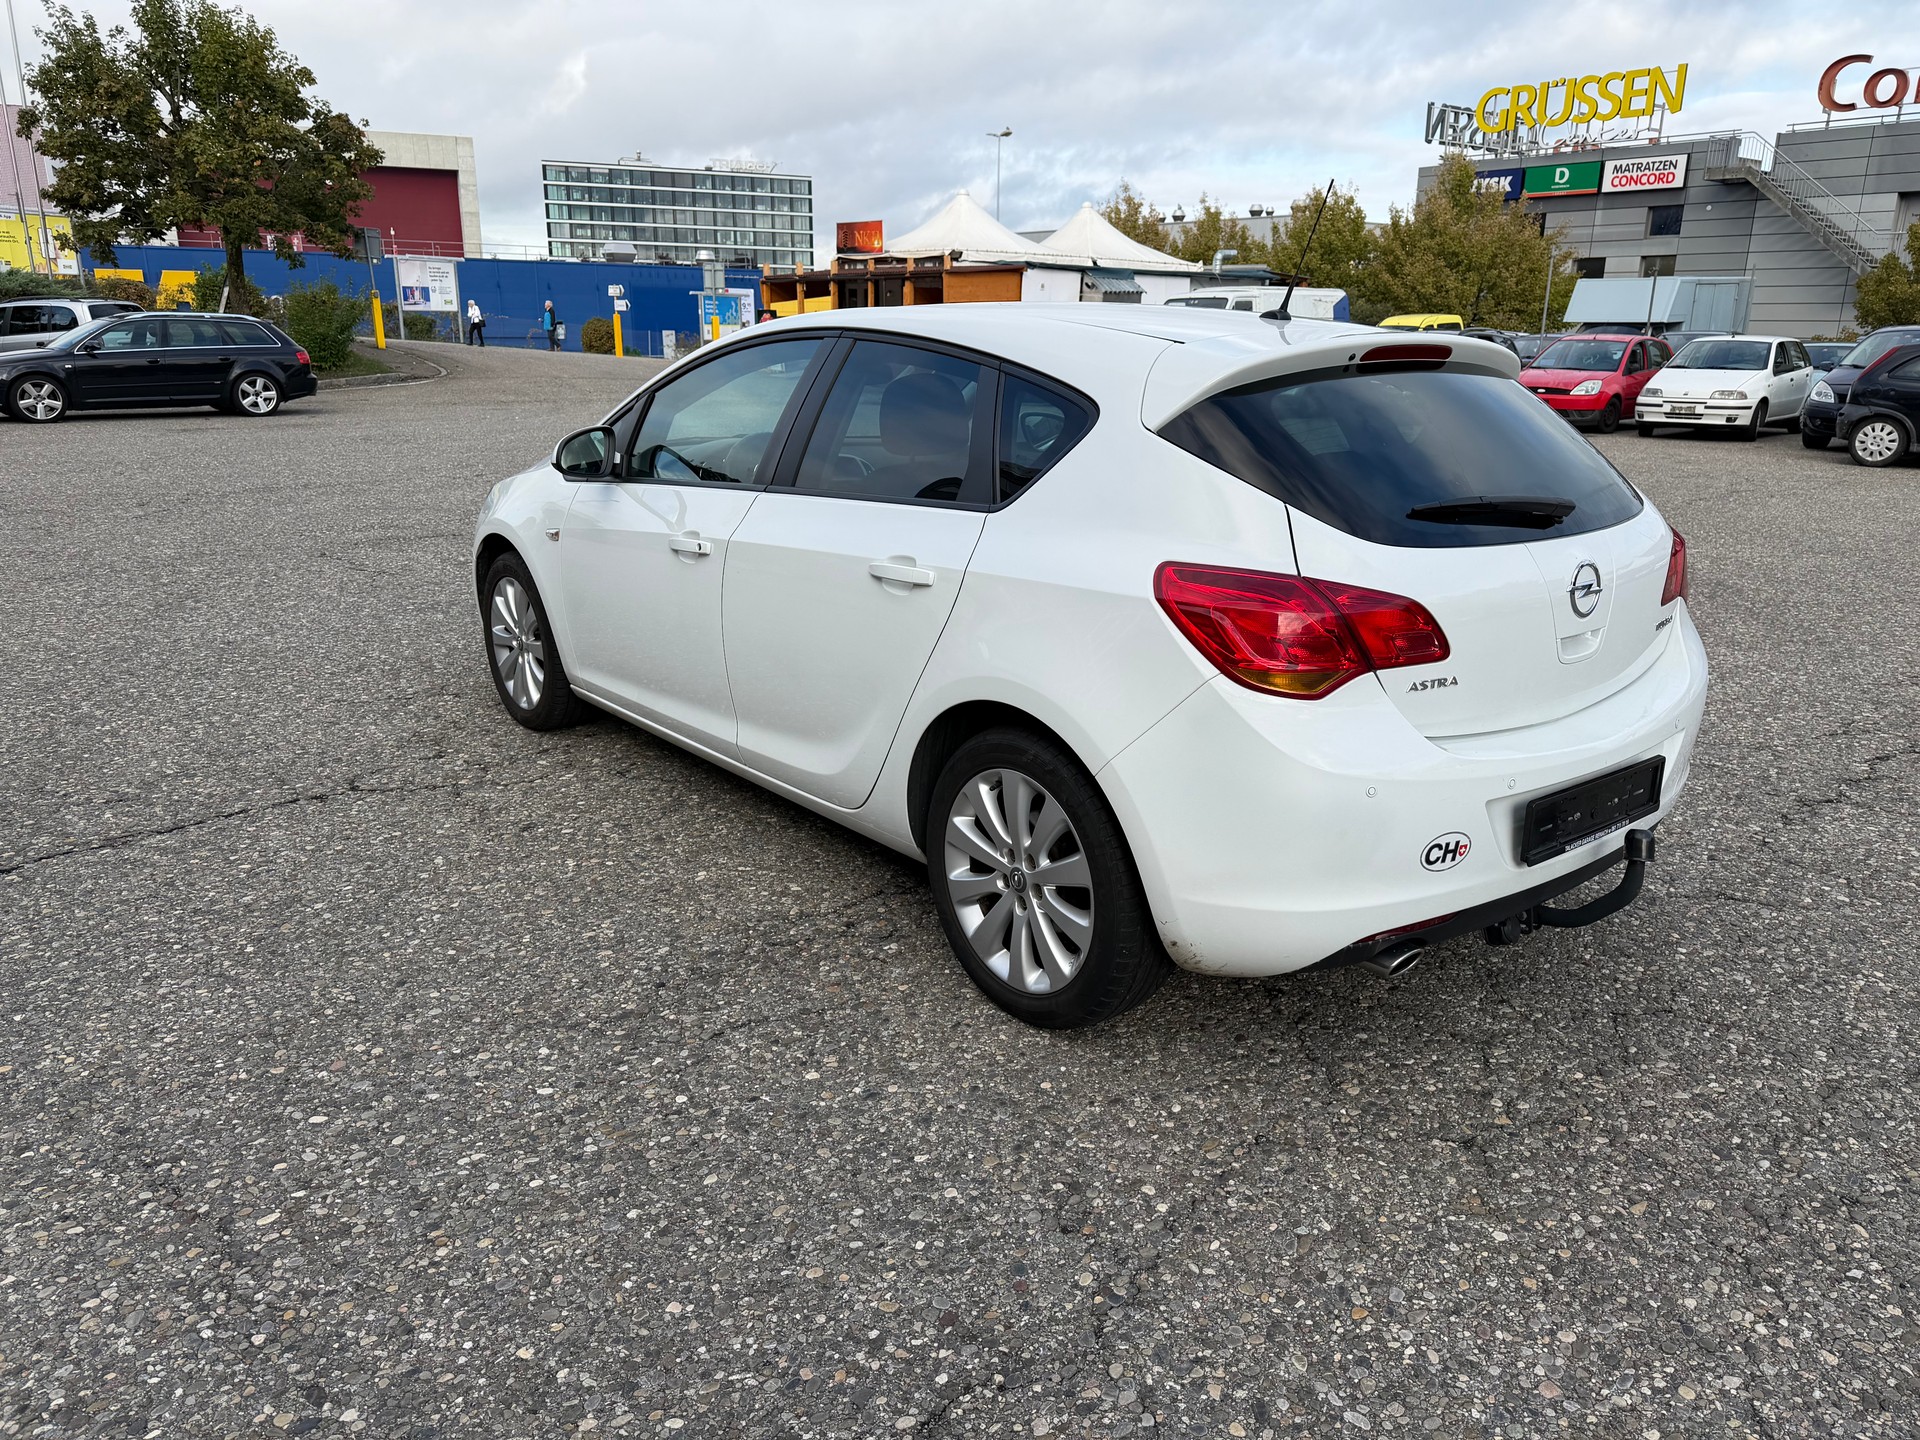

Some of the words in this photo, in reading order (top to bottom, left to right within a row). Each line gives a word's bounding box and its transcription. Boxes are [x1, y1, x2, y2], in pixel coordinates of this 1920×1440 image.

[1818, 54, 1920, 112] Co
[1475, 63, 1688, 134] GRÜSSEN
[1539, 112, 1646, 149] Center
[1554, 167, 1570, 184] D
[1612, 160, 1678, 175] MATRATZEN
[1611, 171, 1675, 188] CONCORD
[1406, 676, 1458, 693] ASTRA
[1425, 840, 1460, 866] CH
